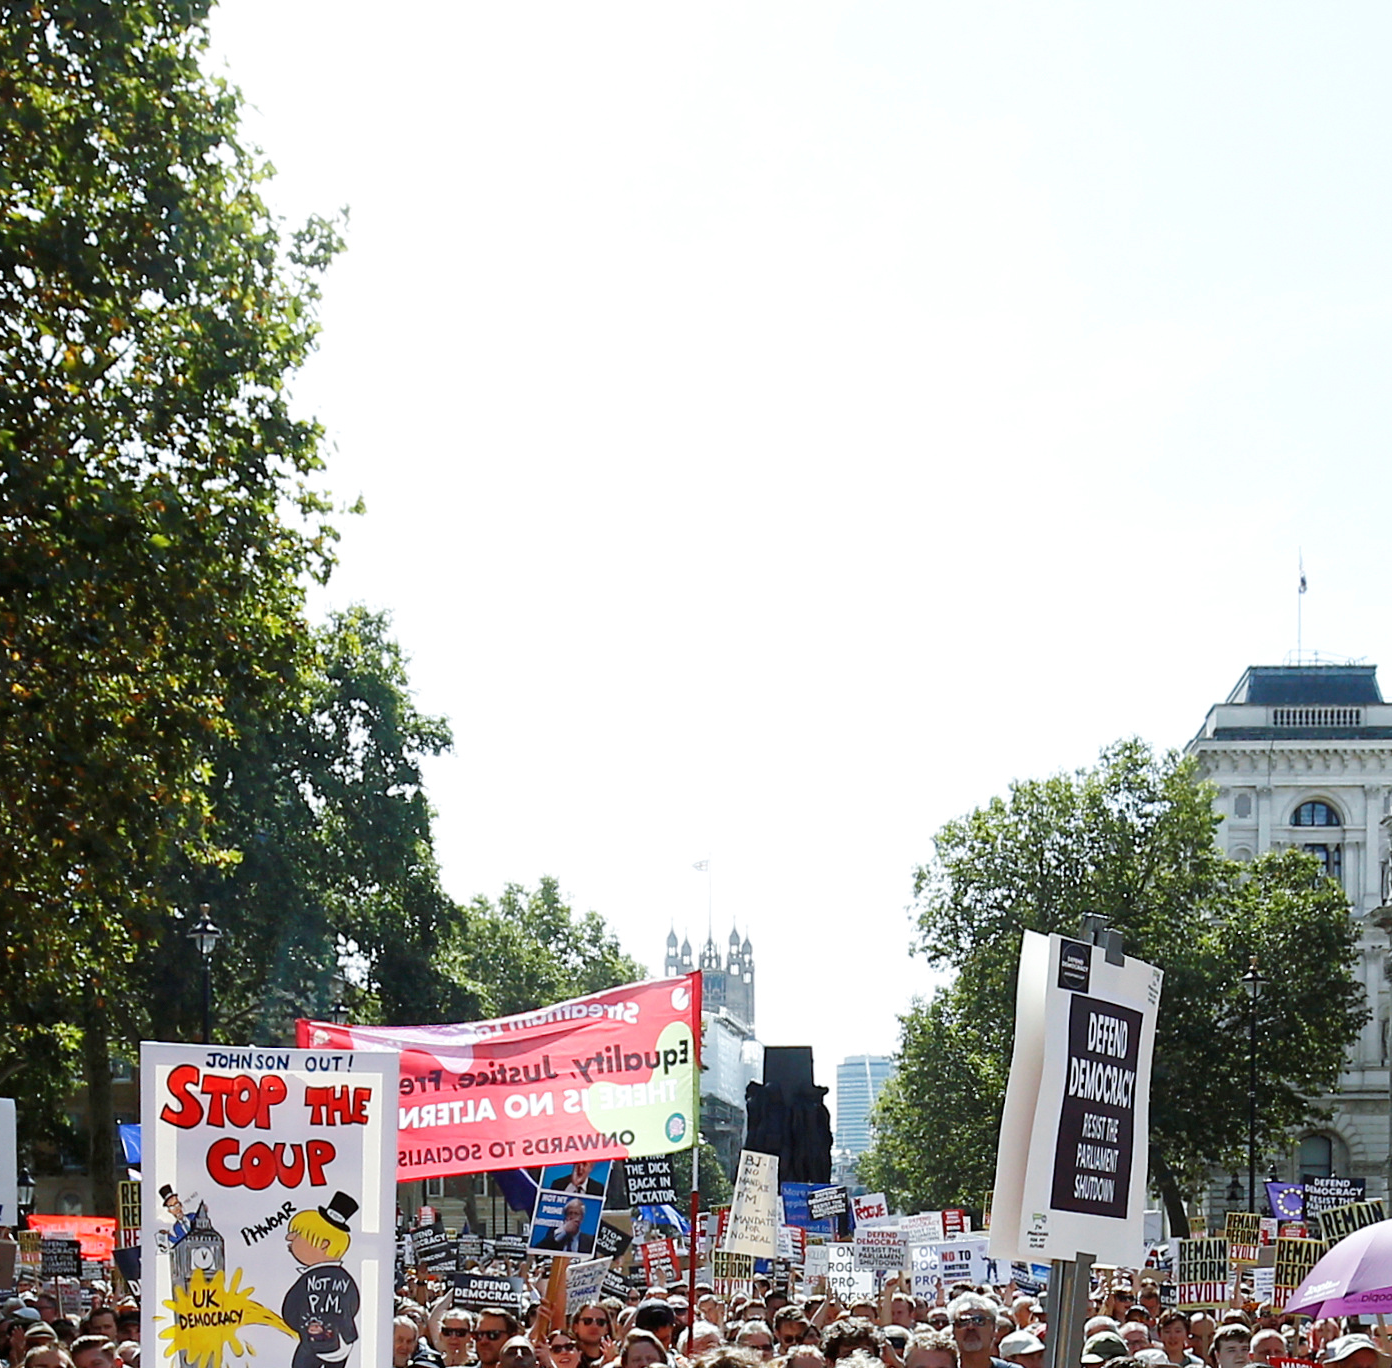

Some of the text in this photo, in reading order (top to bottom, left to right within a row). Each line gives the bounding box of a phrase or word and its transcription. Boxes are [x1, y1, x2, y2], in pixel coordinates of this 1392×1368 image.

[1088, 1012, 1129, 1059] DEFEND
[206, 1053, 353, 1072] JOHNSON OUT!
[1069, 1057, 1135, 1109] DEMOCRACY
[160, 1064, 372, 1130] STOP THE
[1082, 1112, 1119, 1143] RESIST THE
[206, 1137, 336, 1191] COUP
[1076, 1142, 1119, 1173] PARLIAMENT
[625, 1163, 671, 1175] THE DICK
[628, 1176, 672, 1191] BACK IN
[1074, 1174, 1115, 1203] SHUTDOWN
[1305, 1184, 1363, 1196] DEMOCRACY
[1314, 1178, 1350, 1187] DEFEND
[629, 1190, 677, 1205] DICTATOR
[737, 1192, 757, 1205] PM
[855, 1203, 886, 1219] ROGUE
[1322, 1200, 1386, 1236] REMAIN
[240, 1201, 297, 1246] PHWOAR
[734, 1214, 775, 1227] MANDATE
[1227, 1214, 1260, 1229] REMAIN
[731, 1231, 771, 1244] NO-DEAL
[856, 1238, 908, 1246] DEMOCRACY
[1227, 1229, 1259, 1244] REFORM
[942, 1250, 971, 1261] NO TO
[1179, 1240, 1228, 1260] REMAIN
[714, 1262, 751, 1278] REFORM
[1179, 1261, 1227, 1282] REFORM
[307, 1276, 349, 1294] NOT MY
[454, 1286, 522, 1302] DEMOCRACY
[470, 1279, 510, 1291] DEFEND
[1178, 1282, 1228, 1304] REVOLT
[193, 1290, 220, 1308] UK
[308, 1295, 342, 1314] P.M.
[179, 1310, 243, 1330] DEMOCRACY
